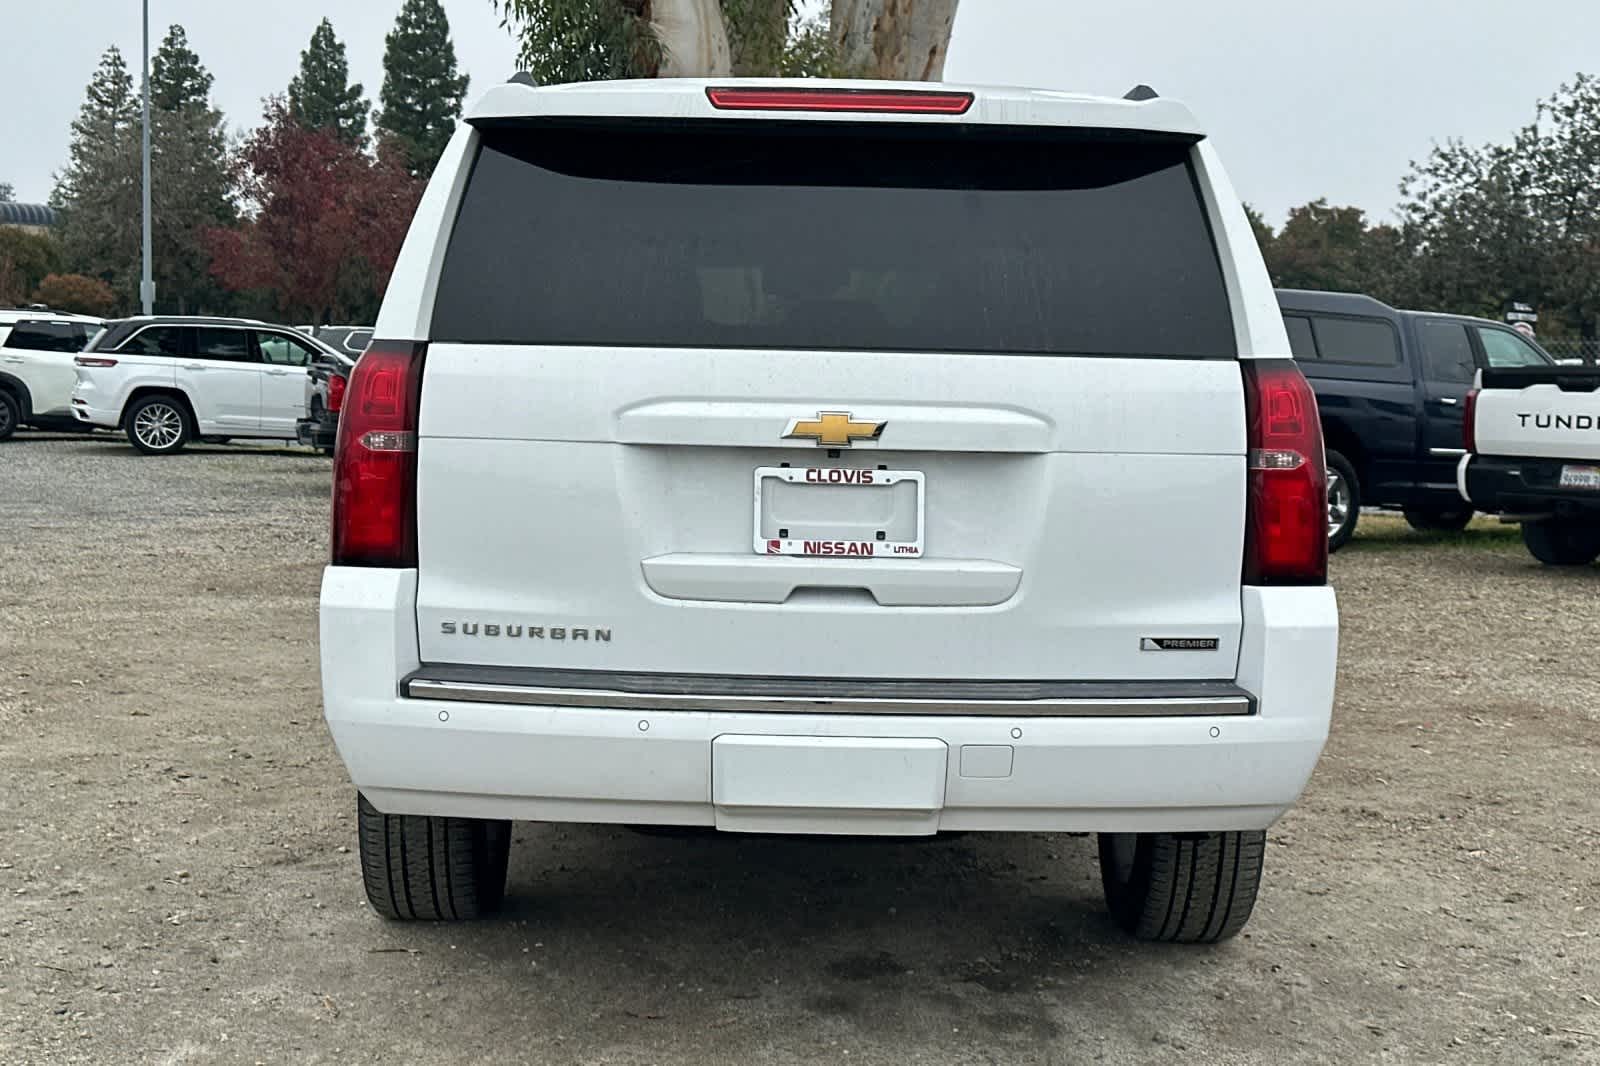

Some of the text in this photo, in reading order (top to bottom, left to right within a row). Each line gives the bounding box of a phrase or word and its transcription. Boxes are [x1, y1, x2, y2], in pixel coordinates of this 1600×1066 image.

[1516, 413, 1600, 430] TUND
[805, 468, 874, 484] CLOVIS
[803, 541, 919, 556] NISSAN LITHIA
[440, 621, 612, 642] SUBURBAN
[1163, 639, 1215, 649] PREMIER
